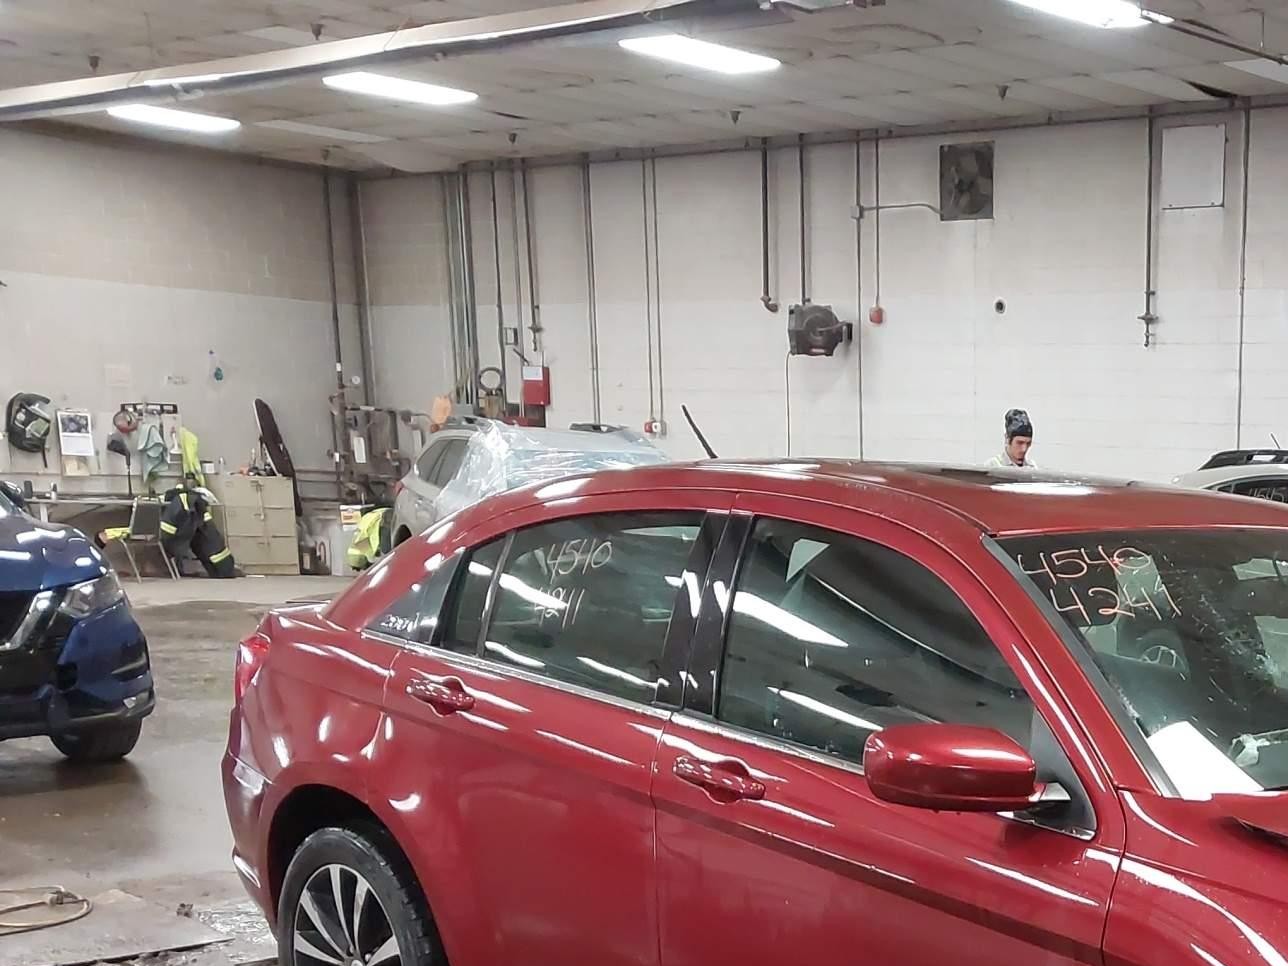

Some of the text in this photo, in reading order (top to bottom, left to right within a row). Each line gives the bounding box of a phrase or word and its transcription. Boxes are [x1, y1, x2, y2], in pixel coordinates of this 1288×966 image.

[547, 538, 612, 584] 4540
[1017, 545, 1151, 585] 4540
[1050, 575, 1182, 625] 4241
